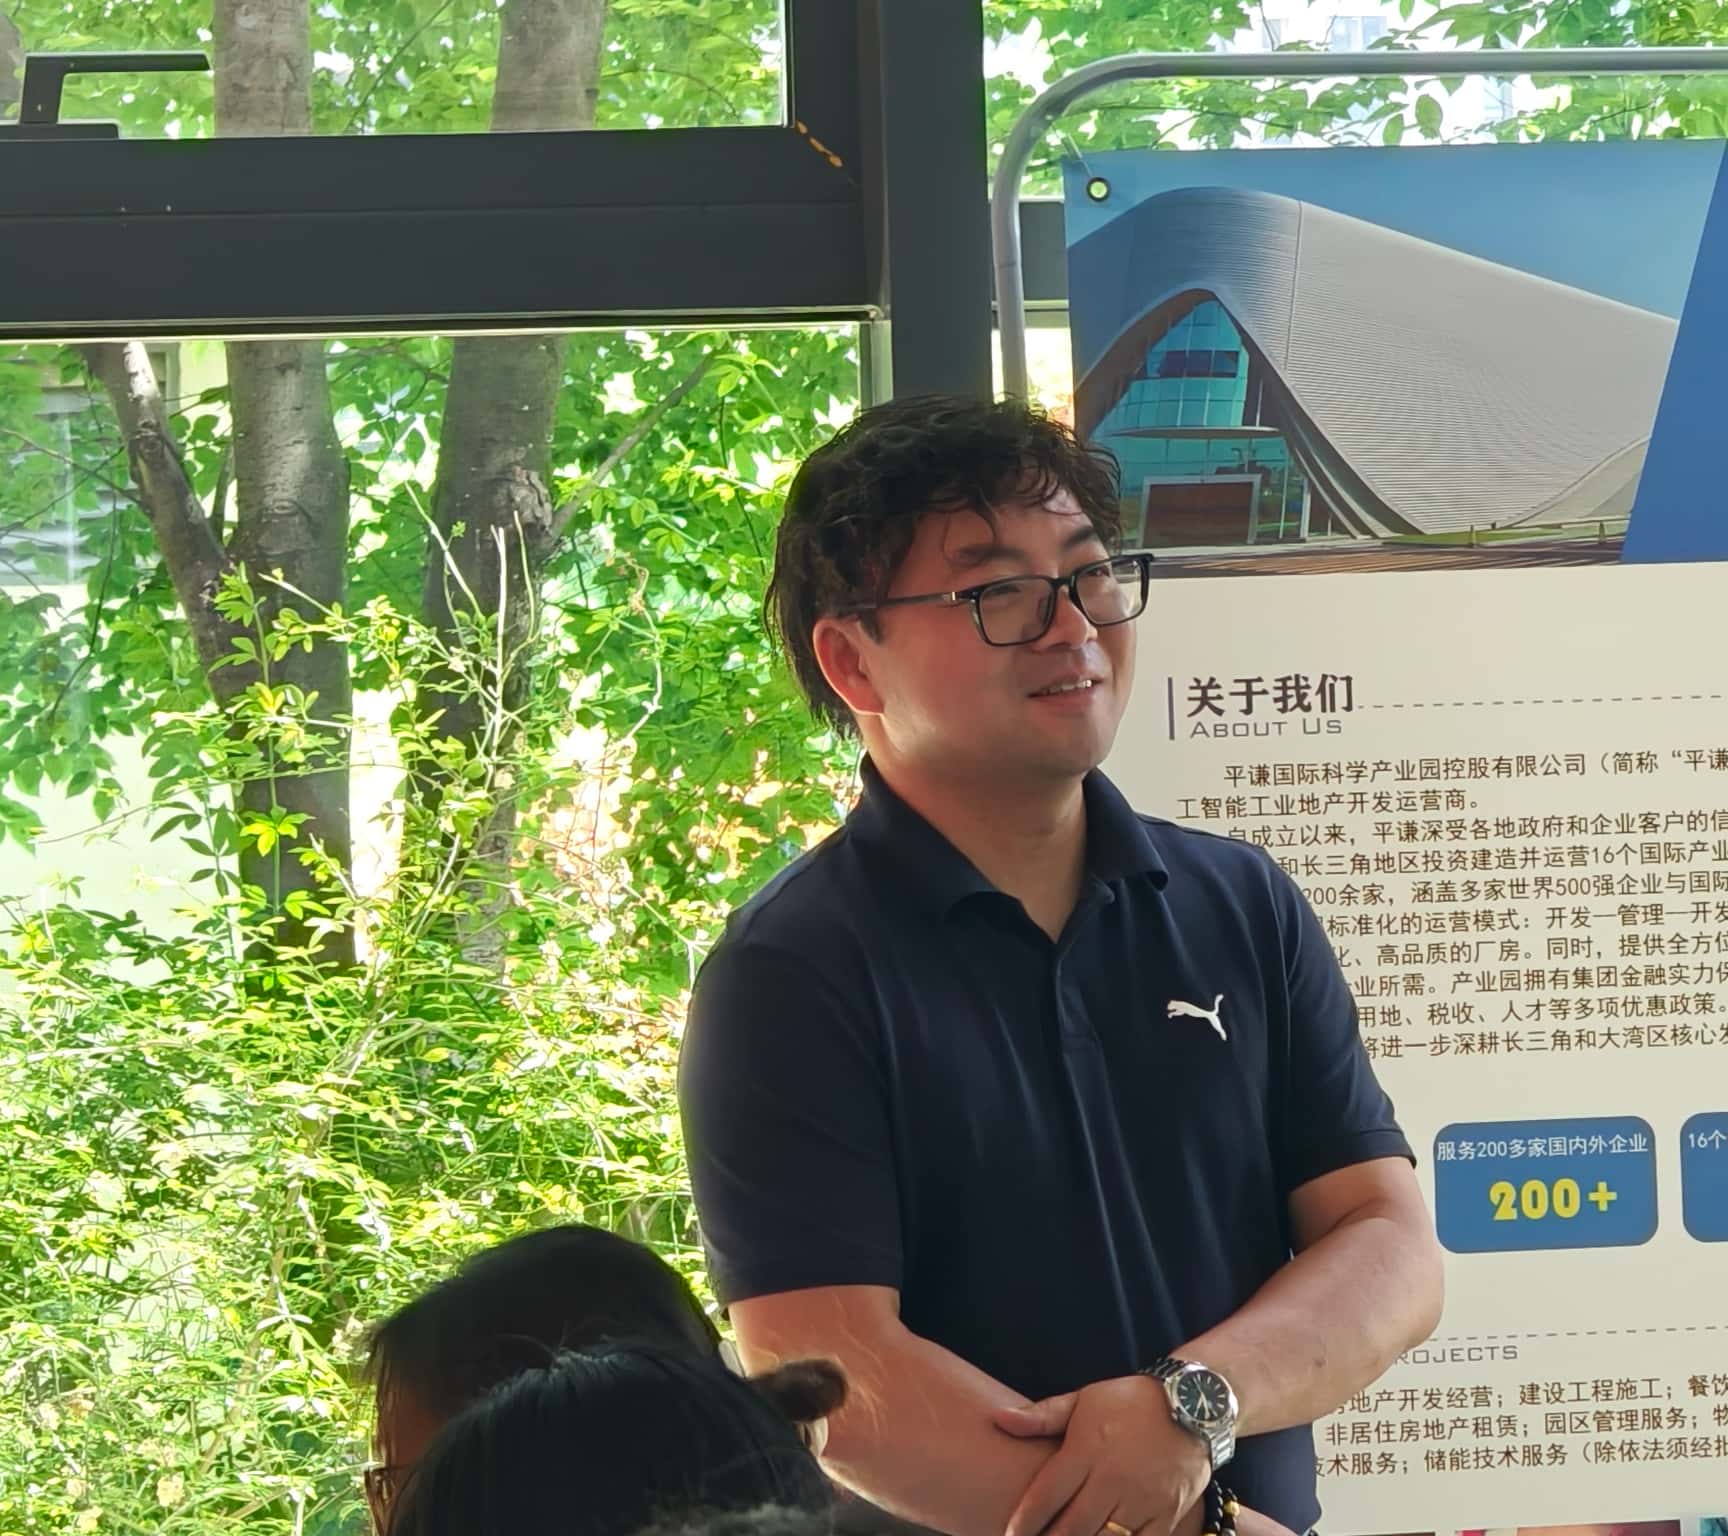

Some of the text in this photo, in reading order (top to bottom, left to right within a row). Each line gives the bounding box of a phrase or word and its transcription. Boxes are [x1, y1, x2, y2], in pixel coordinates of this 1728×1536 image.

[1186, 673, 1355, 719] 关于我们
[1437, 1132, 1649, 1161] 服务200多家国内外企业
[1489, 1177, 1618, 1221] 200+
